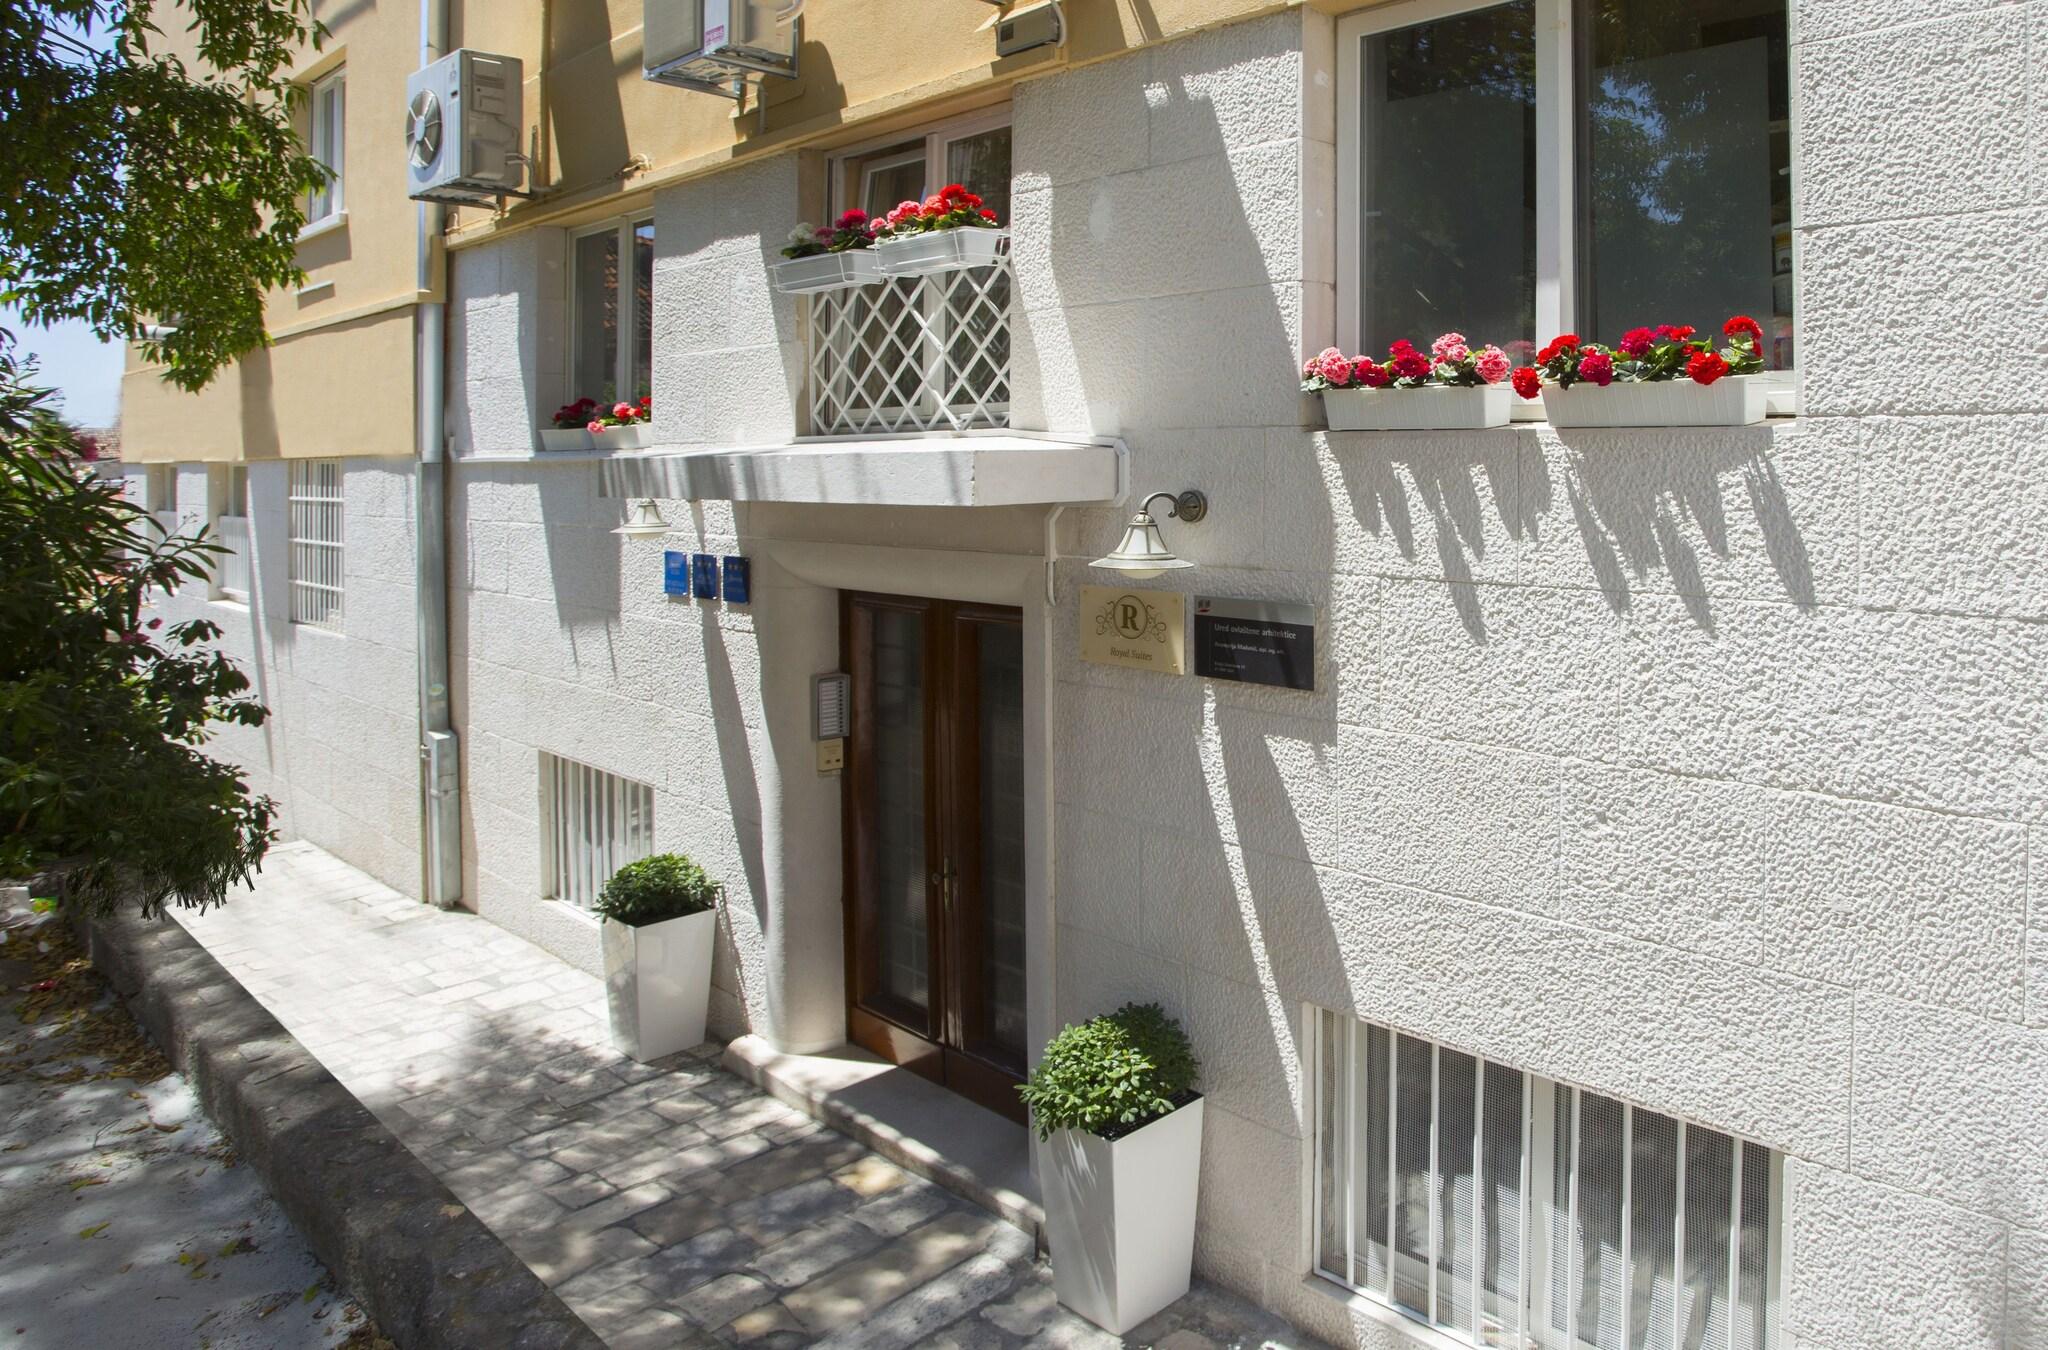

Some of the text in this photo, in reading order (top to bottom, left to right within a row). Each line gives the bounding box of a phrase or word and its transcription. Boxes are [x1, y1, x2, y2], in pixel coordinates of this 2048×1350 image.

[1120, 603, 1140, 631] R
[1110, 646, 1153, 661] Royal Suites
